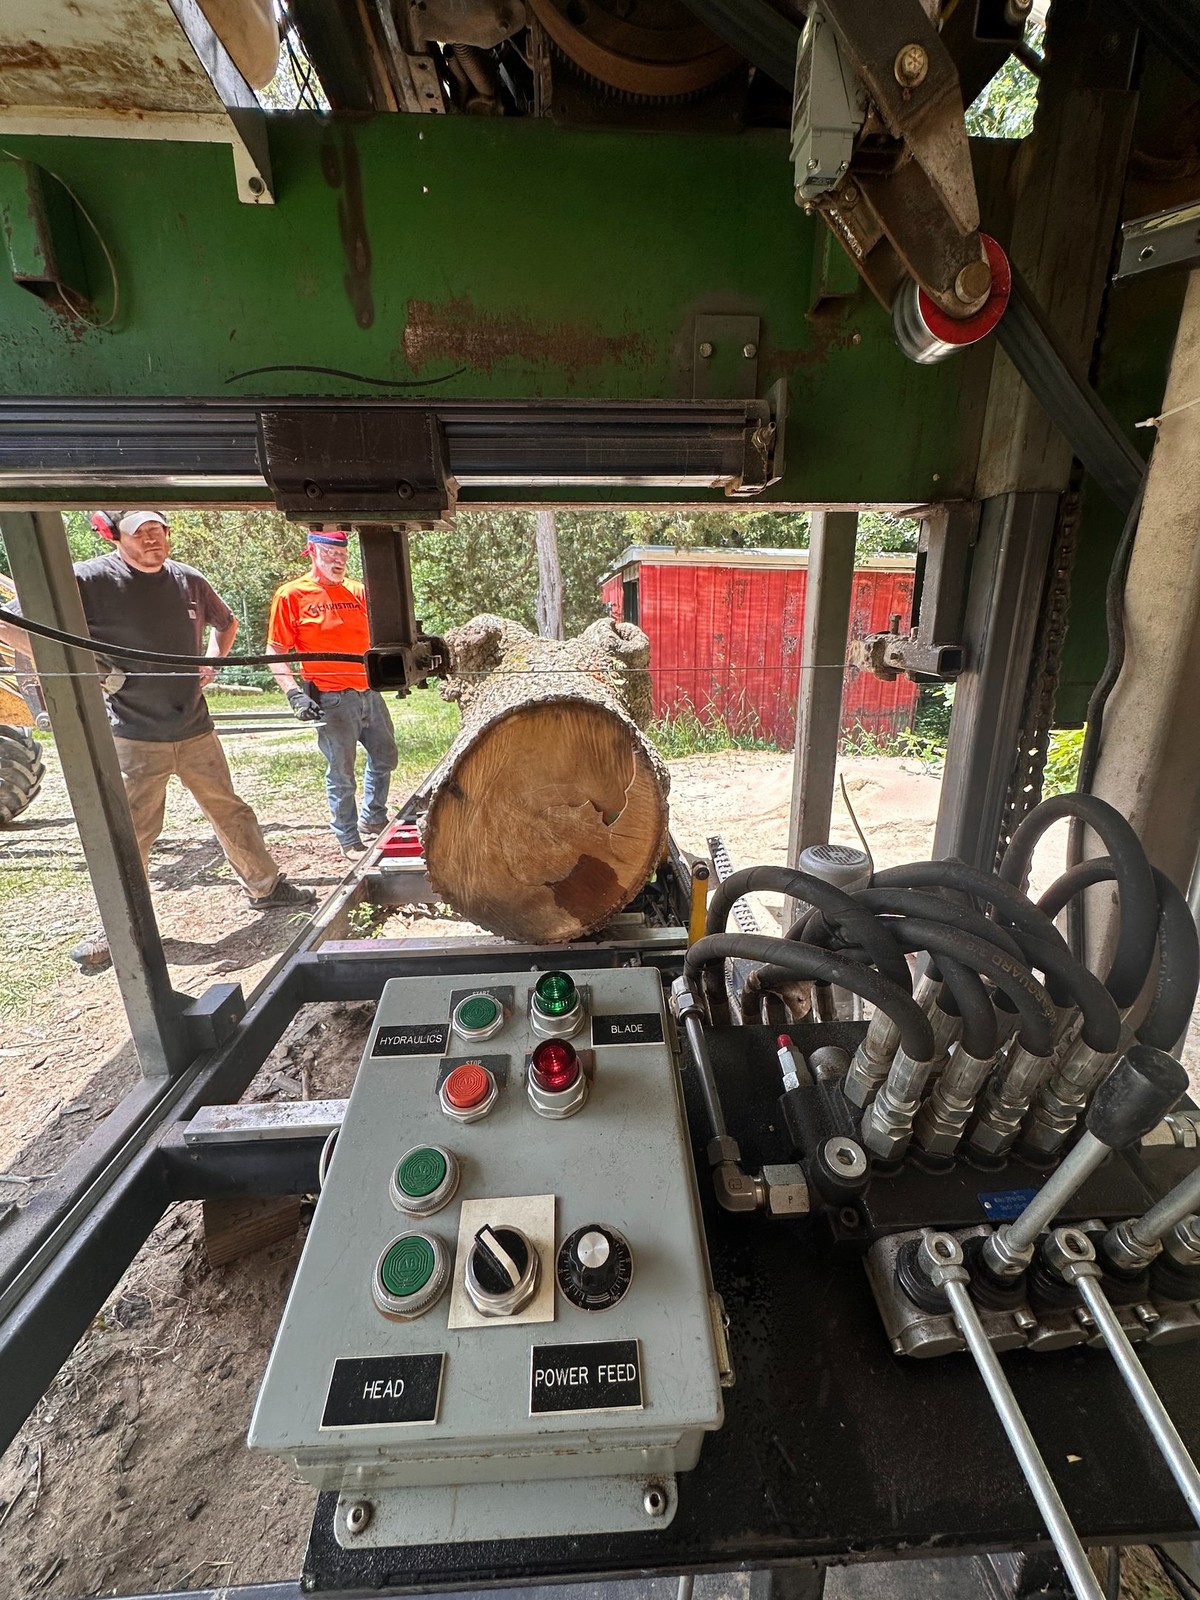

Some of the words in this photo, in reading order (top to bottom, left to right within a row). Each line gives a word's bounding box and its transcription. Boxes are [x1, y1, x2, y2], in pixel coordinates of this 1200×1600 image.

[610, 1023, 644, 1035] BLADE
[379, 1033, 443, 1046] HYDRAULICS
[535, 1366, 589, 1388] POWER
[598, 1363, 637, 1384] FEED
[362, 1379, 405, 1400] HEAD
